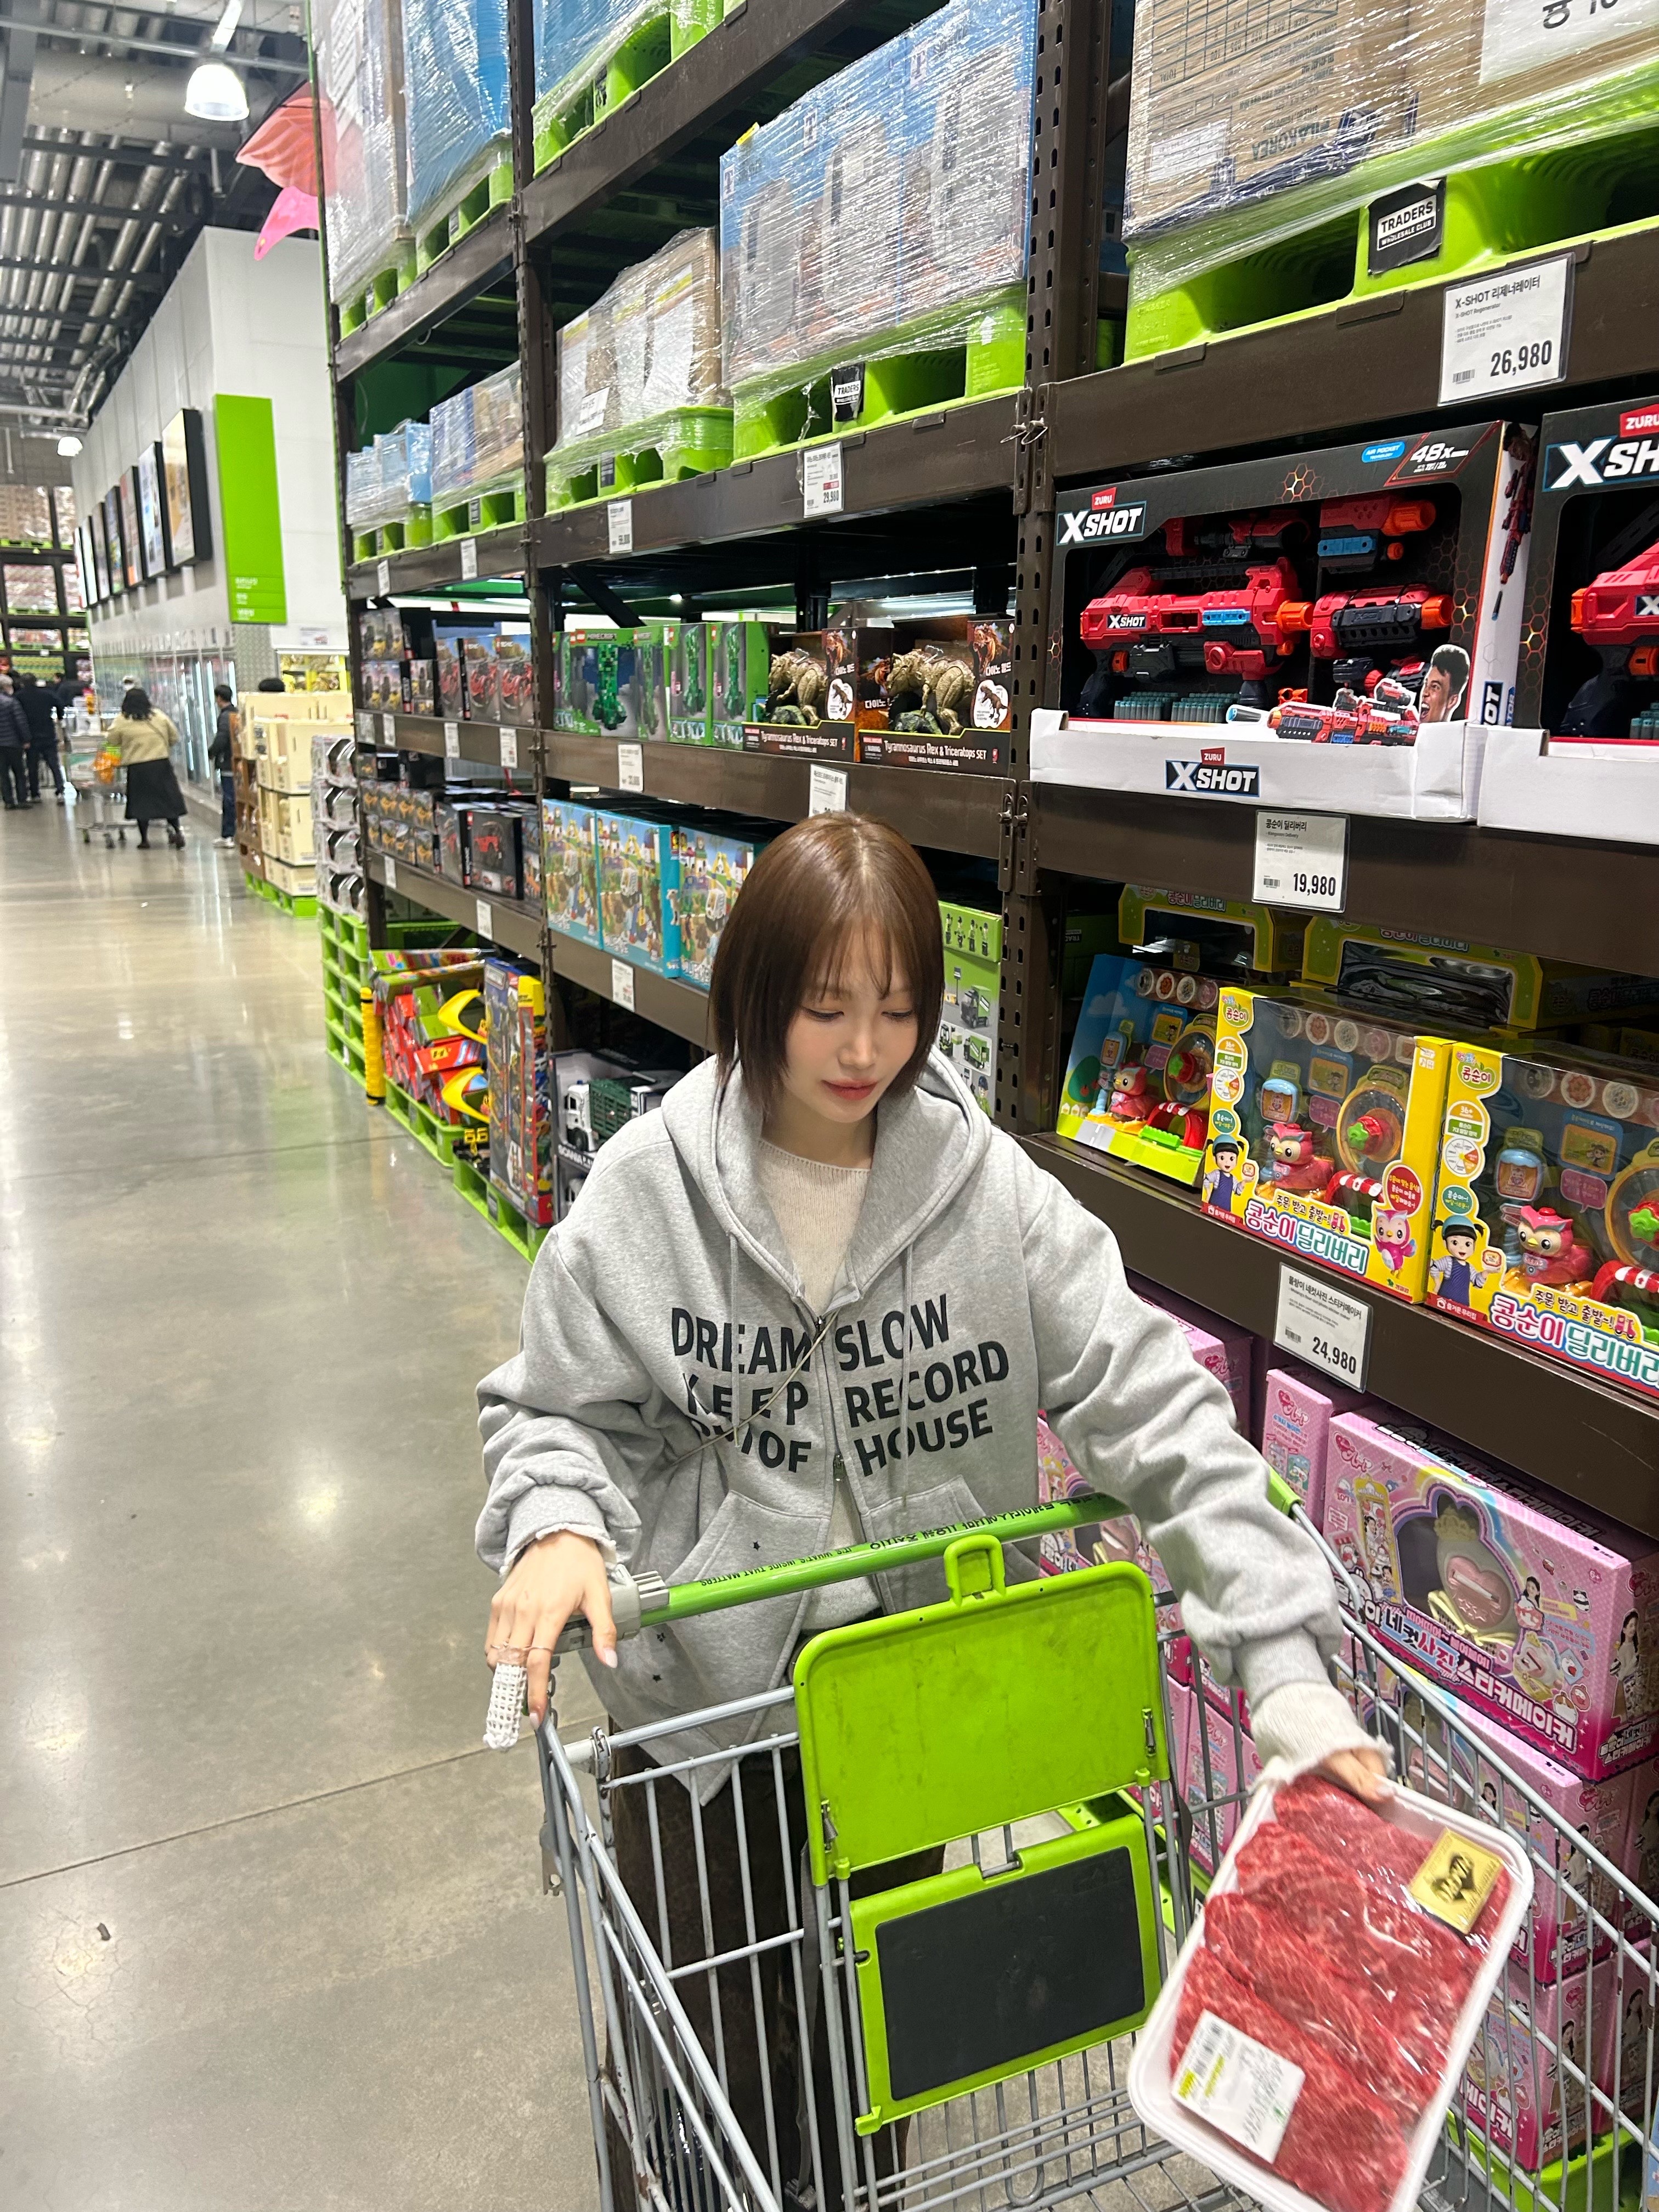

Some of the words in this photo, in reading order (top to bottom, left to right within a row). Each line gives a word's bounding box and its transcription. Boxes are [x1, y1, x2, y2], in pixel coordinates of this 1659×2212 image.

[1160, 69, 1176, 83] TOTAL
[1252, 132, 1296, 163] KOREA
[1381, 201, 1433, 233] TRADERS
[1381, 227, 1414, 245] WHOLESALE
[1416, 219, 1432, 231] CLUB
[1455, 291, 1491, 309] X-SHOT
[1492, 275, 1541, 298] 리제너레이터
[1490, 340, 1552, 377] 26,980
[838, 383, 860, 396] TRADERS
[1626, 414, 1659, 430] ZURU
[1376, 444, 1400, 454] POCKET
[1094, 495, 1113, 505] ZURU
[985, 664, 1001, 676] 다이노
[865, 699, 887, 709] 다이노
[830, 738, 838, 747] SET
[884, 740, 926, 754] Tyrannosaurus
[927, 743, 939, 756] Rex
[939, 748, 944, 756] &
[945, 746, 975, 759] Triceratops
[976, 749, 987, 760] SET
[1204, 753, 1222, 761] ZURU
[1266, 819, 1283, 830] 콩순이
[1284, 820, 1307, 832] 딜리버리
[1294, 873, 1336, 896] 19,980
[1226, 1007, 1247, 1021] 콩순이
[1462, 1065, 1491, 1084] 콩순이
[1460, 1105, 1473, 1114] 36+
[1277, 1194, 1290, 1210] 주문
[1292, 1198, 1307, 1215] 받고
[1246, 1201, 1296, 1242] 콩순이
[1297, 1223, 1366, 1272] 딜리버리
[1305, 1283, 1327, 1301] 네컷사진
[1328, 1295, 1362, 1320] 스티커메이커
[1535, 1290, 1554, 1308] 주문
[1558, 1296, 1578, 1314] 받고
[1492, 1295, 1564, 1346] 콩순이
[672, 1307, 811, 1374] DREAM
[834, 1293, 949, 1372] SLOW
[1312, 1336, 1357, 1374] 24,980
[844, 1340, 1008, 1428] RECORD
[854, 1398, 993, 1477] HOUSE
[1385, 1611, 1455, 1672] 네컷사진
[1457, 1659, 1576, 1751] 스티커메이커
